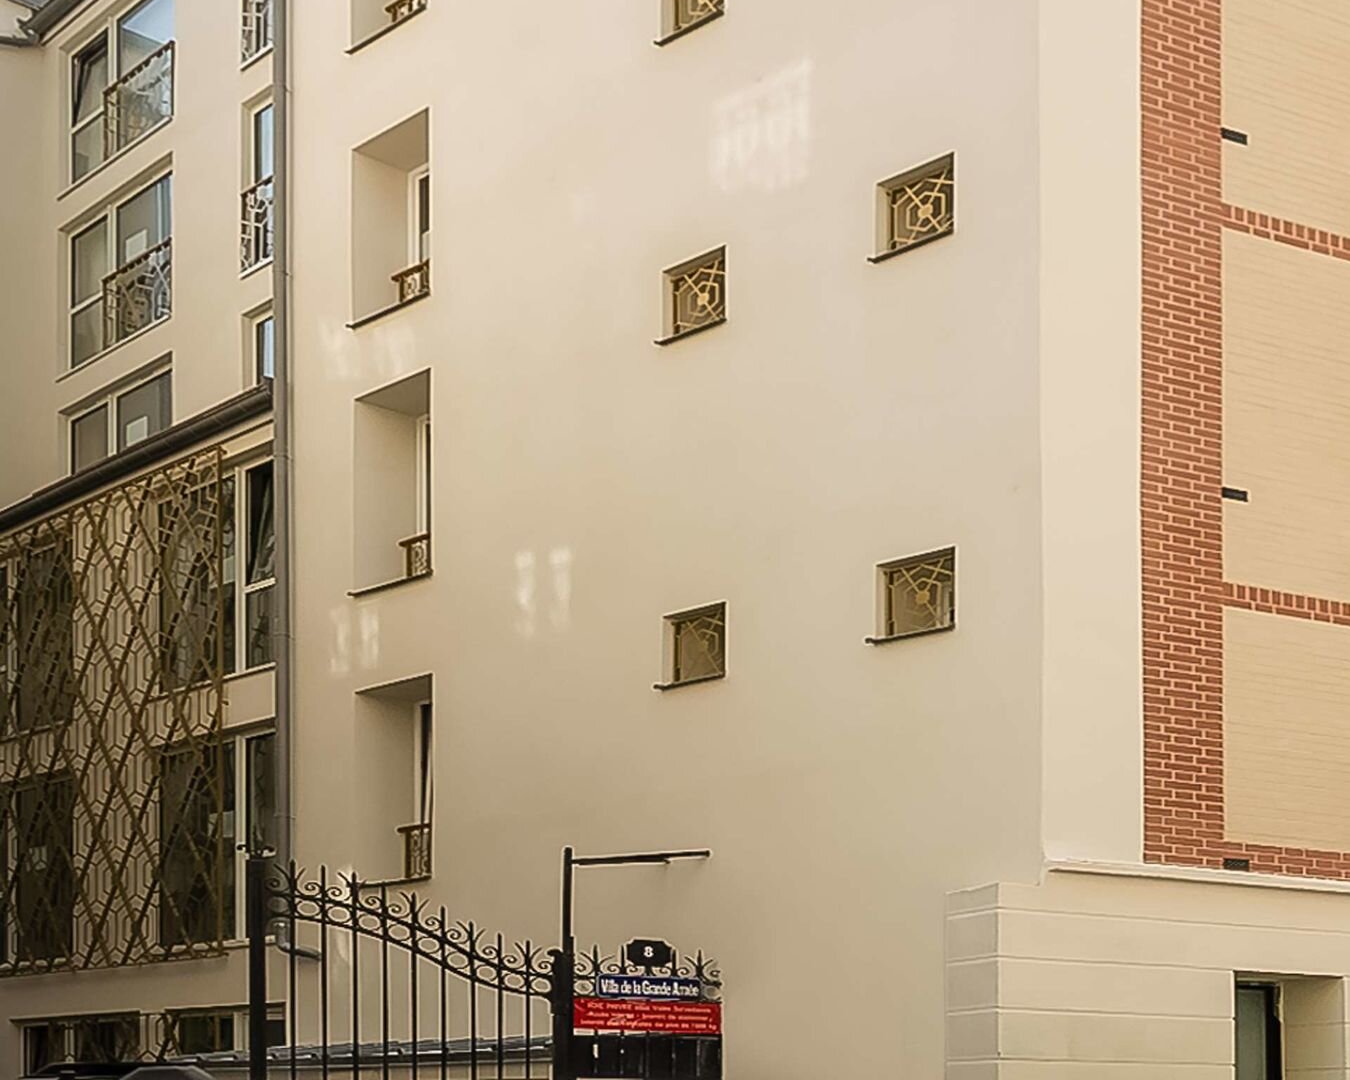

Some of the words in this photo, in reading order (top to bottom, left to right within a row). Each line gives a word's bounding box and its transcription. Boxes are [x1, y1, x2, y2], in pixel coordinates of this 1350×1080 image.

[644, 946, 654, 958] 8
[601, 978, 619, 993] Villa
[621, 980, 632, 994] de
[633, 980, 641, 994] la
[642, 981, 671, 996] Grande
